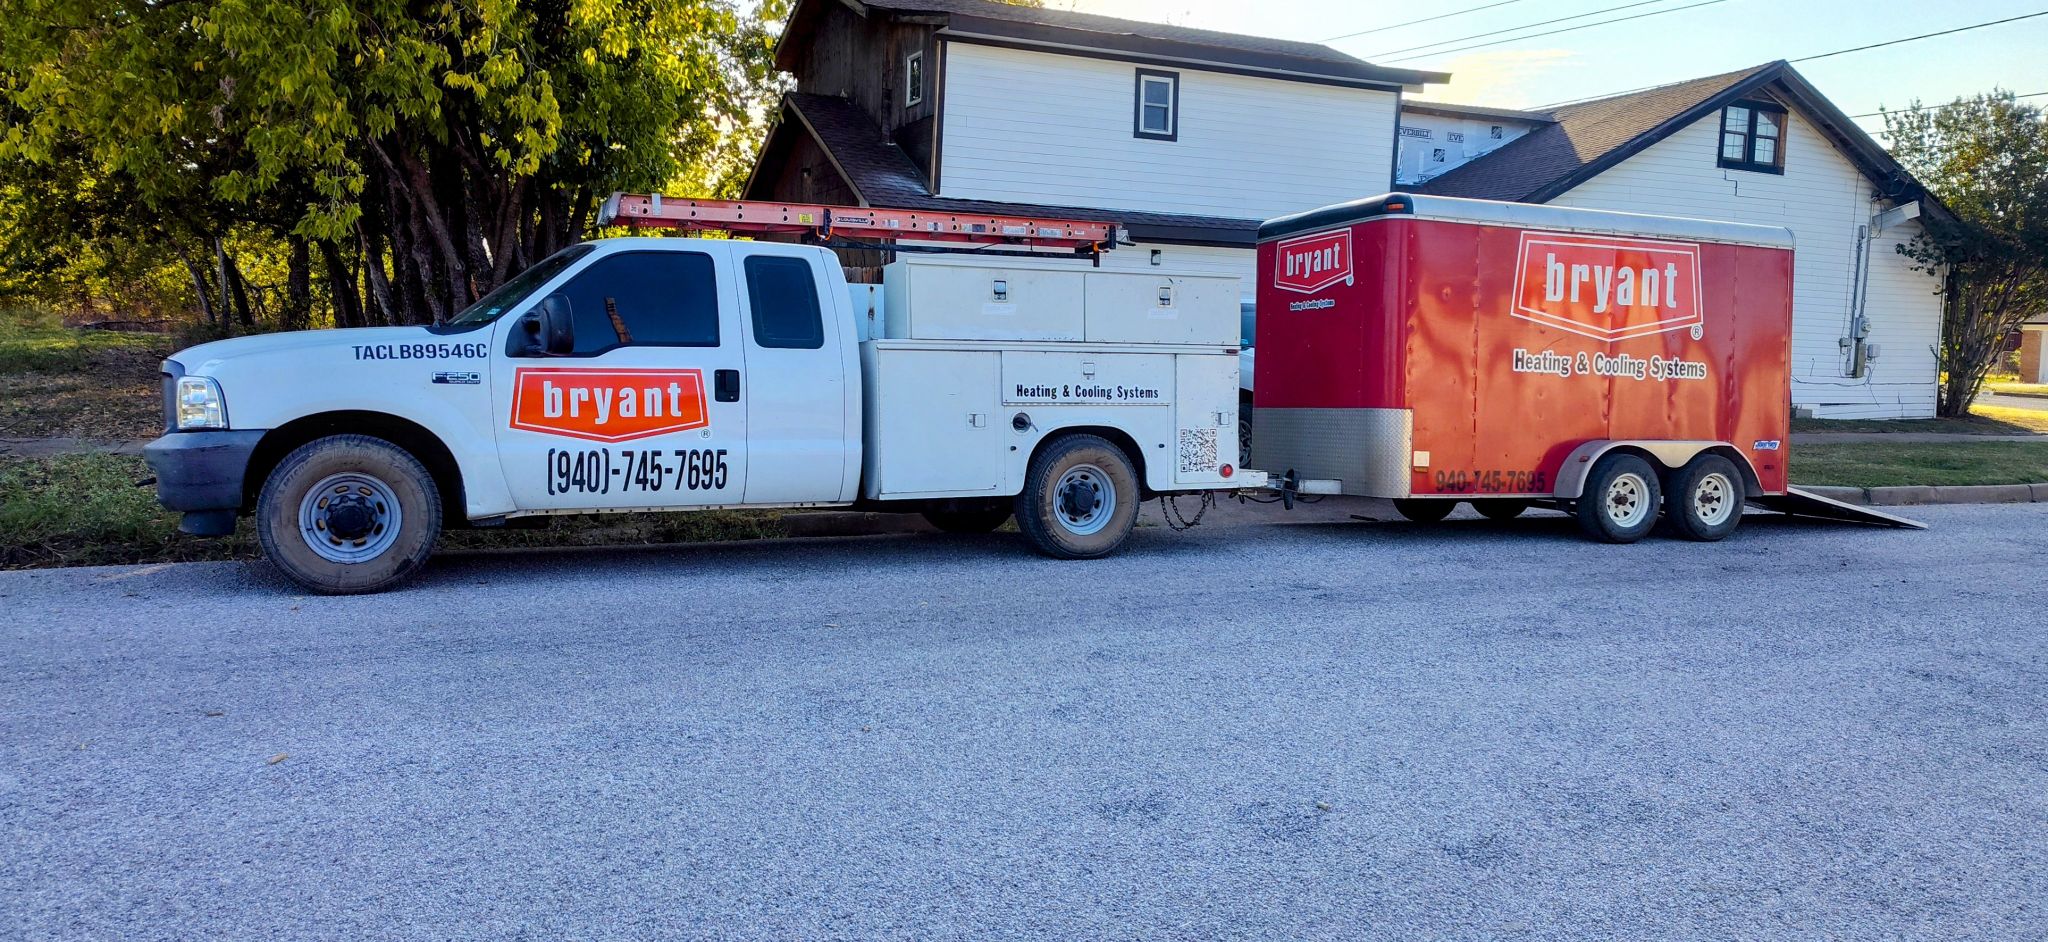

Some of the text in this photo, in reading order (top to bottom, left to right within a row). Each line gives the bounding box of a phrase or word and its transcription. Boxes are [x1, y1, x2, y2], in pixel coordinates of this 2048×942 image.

[1286, 242, 1340, 279] bryant
[1545, 253, 1678, 313] bryant
[352, 343, 487, 360] TACLB89546C
[1514, 349, 1706, 380] Heating & Cooling Systems
[543, 380, 682, 425] bryant
[1016, 384, 1159, 400] Heating & Cooling Systems
[547, 448, 728, 496] (940)-745-7695
[1435, 469, 1545, 492] 940-745-7695
